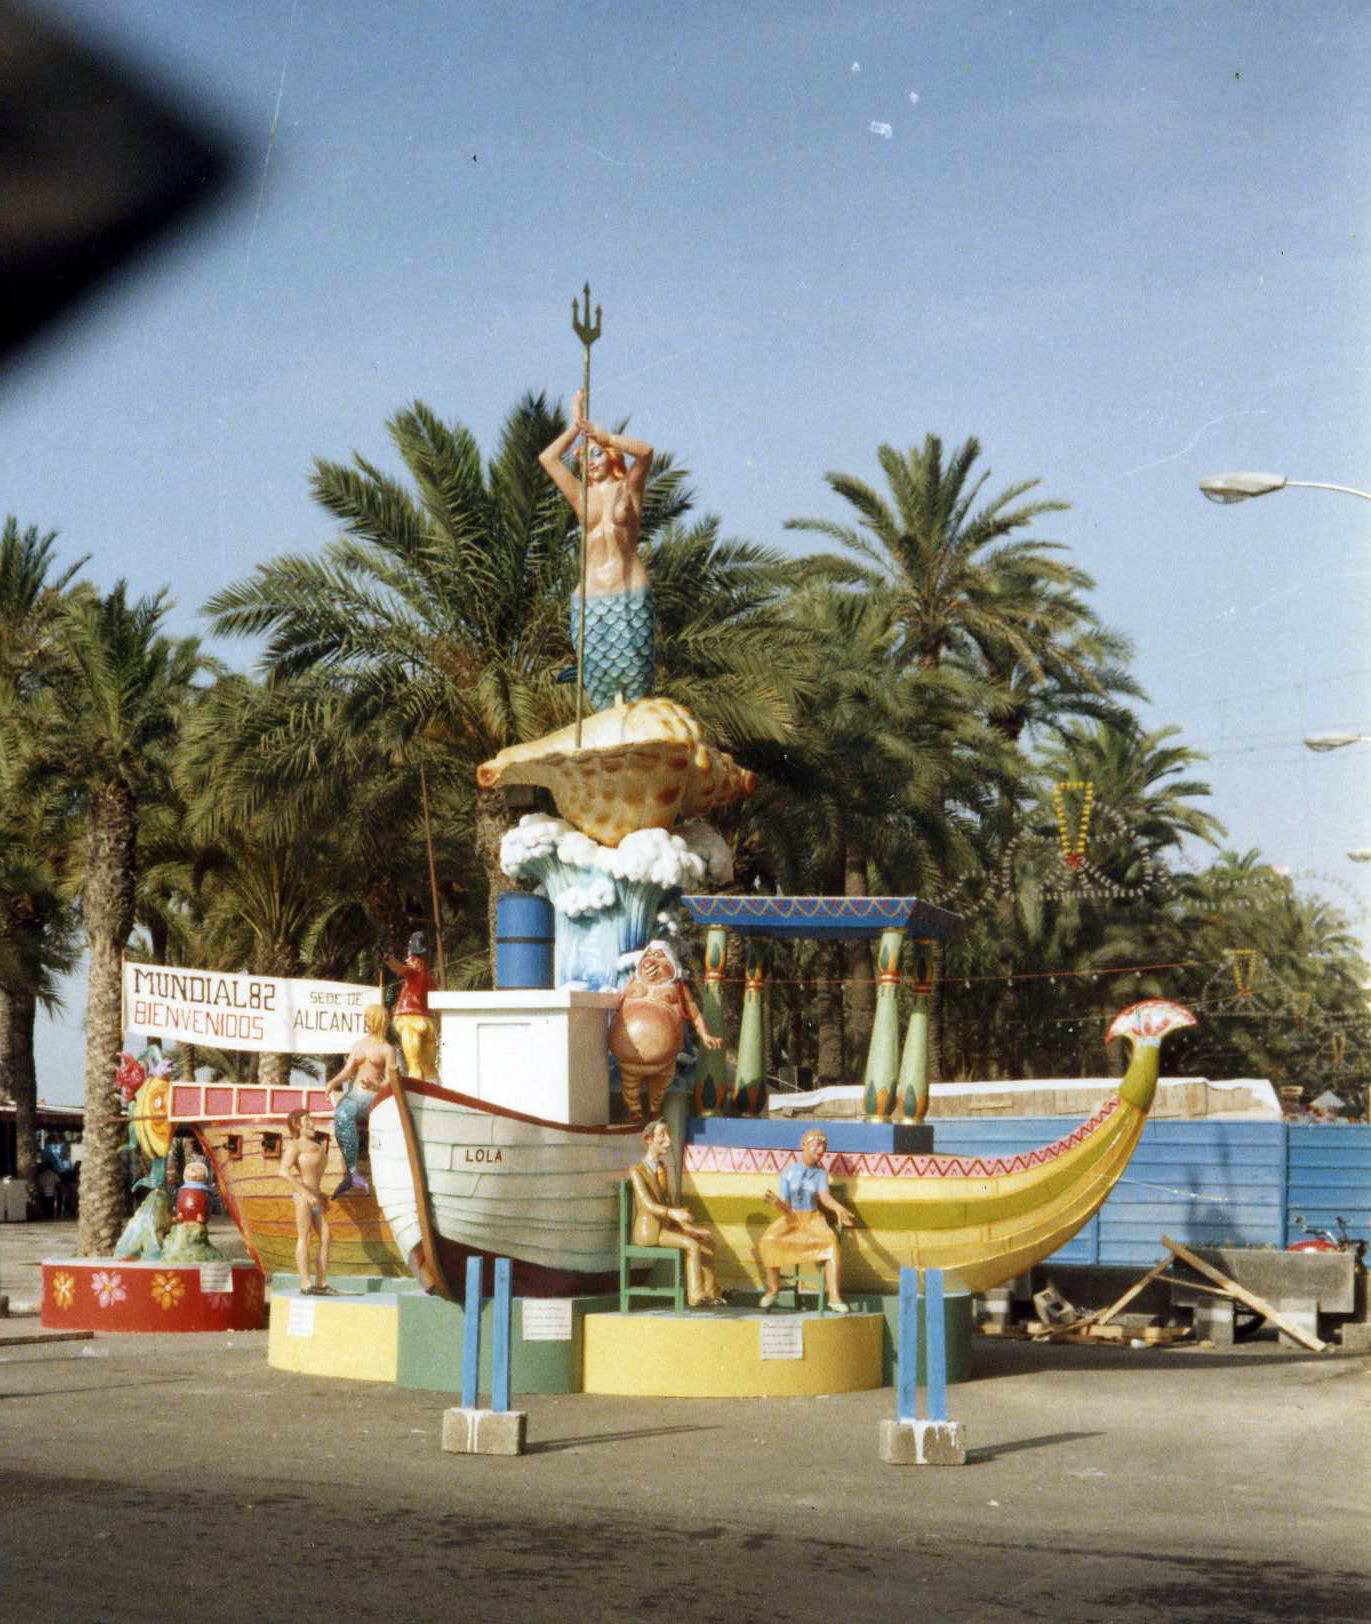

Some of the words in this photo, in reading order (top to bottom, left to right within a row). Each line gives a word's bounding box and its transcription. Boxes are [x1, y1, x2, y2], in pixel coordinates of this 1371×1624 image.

[309, 991, 342, 1006] SEDE
[346, 992, 364, 1007] DE
[134, 1000, 264, 1041] BIENVENIDOS
[465, 1148, 503, 1163] LOLA
